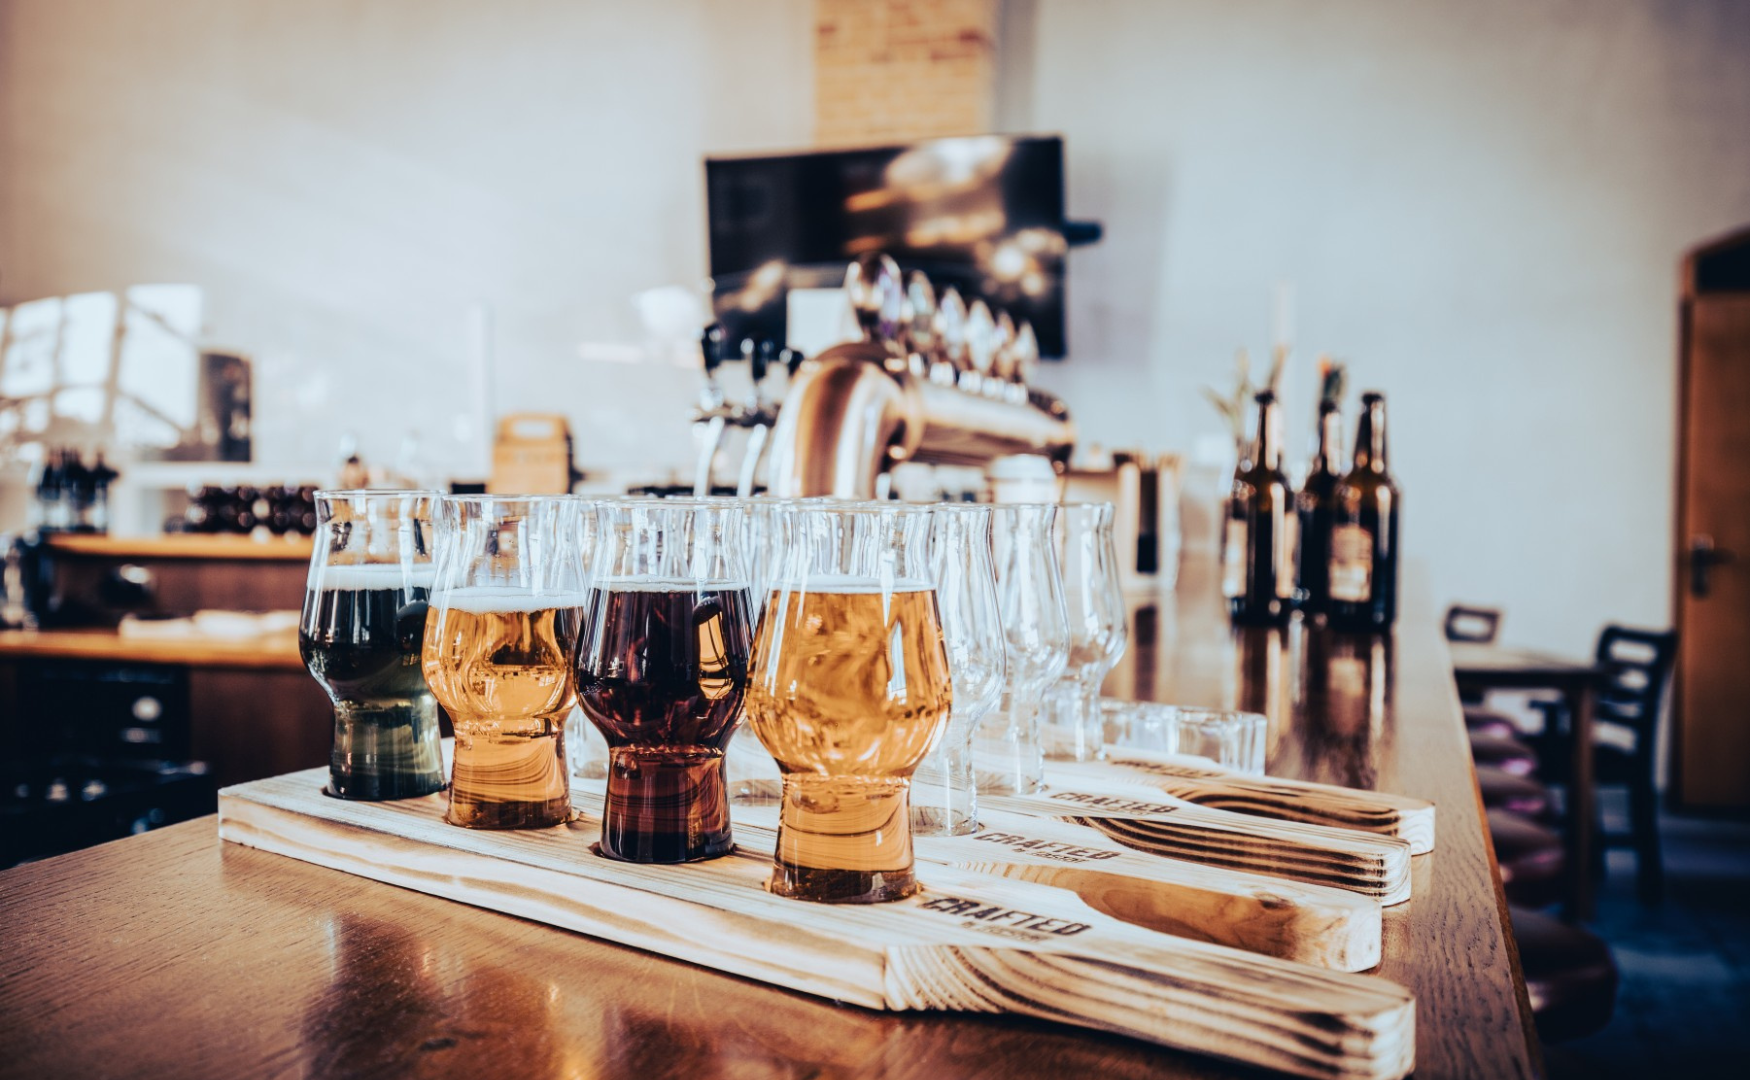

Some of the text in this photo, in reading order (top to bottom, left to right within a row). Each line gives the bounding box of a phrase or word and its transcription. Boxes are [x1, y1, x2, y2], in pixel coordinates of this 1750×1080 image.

[1049, 792, 1179, 813] CRAFTED
[973, 832, 1122, 860] CRAFTED
[922, 897, 1092, 936] CRAFTED
